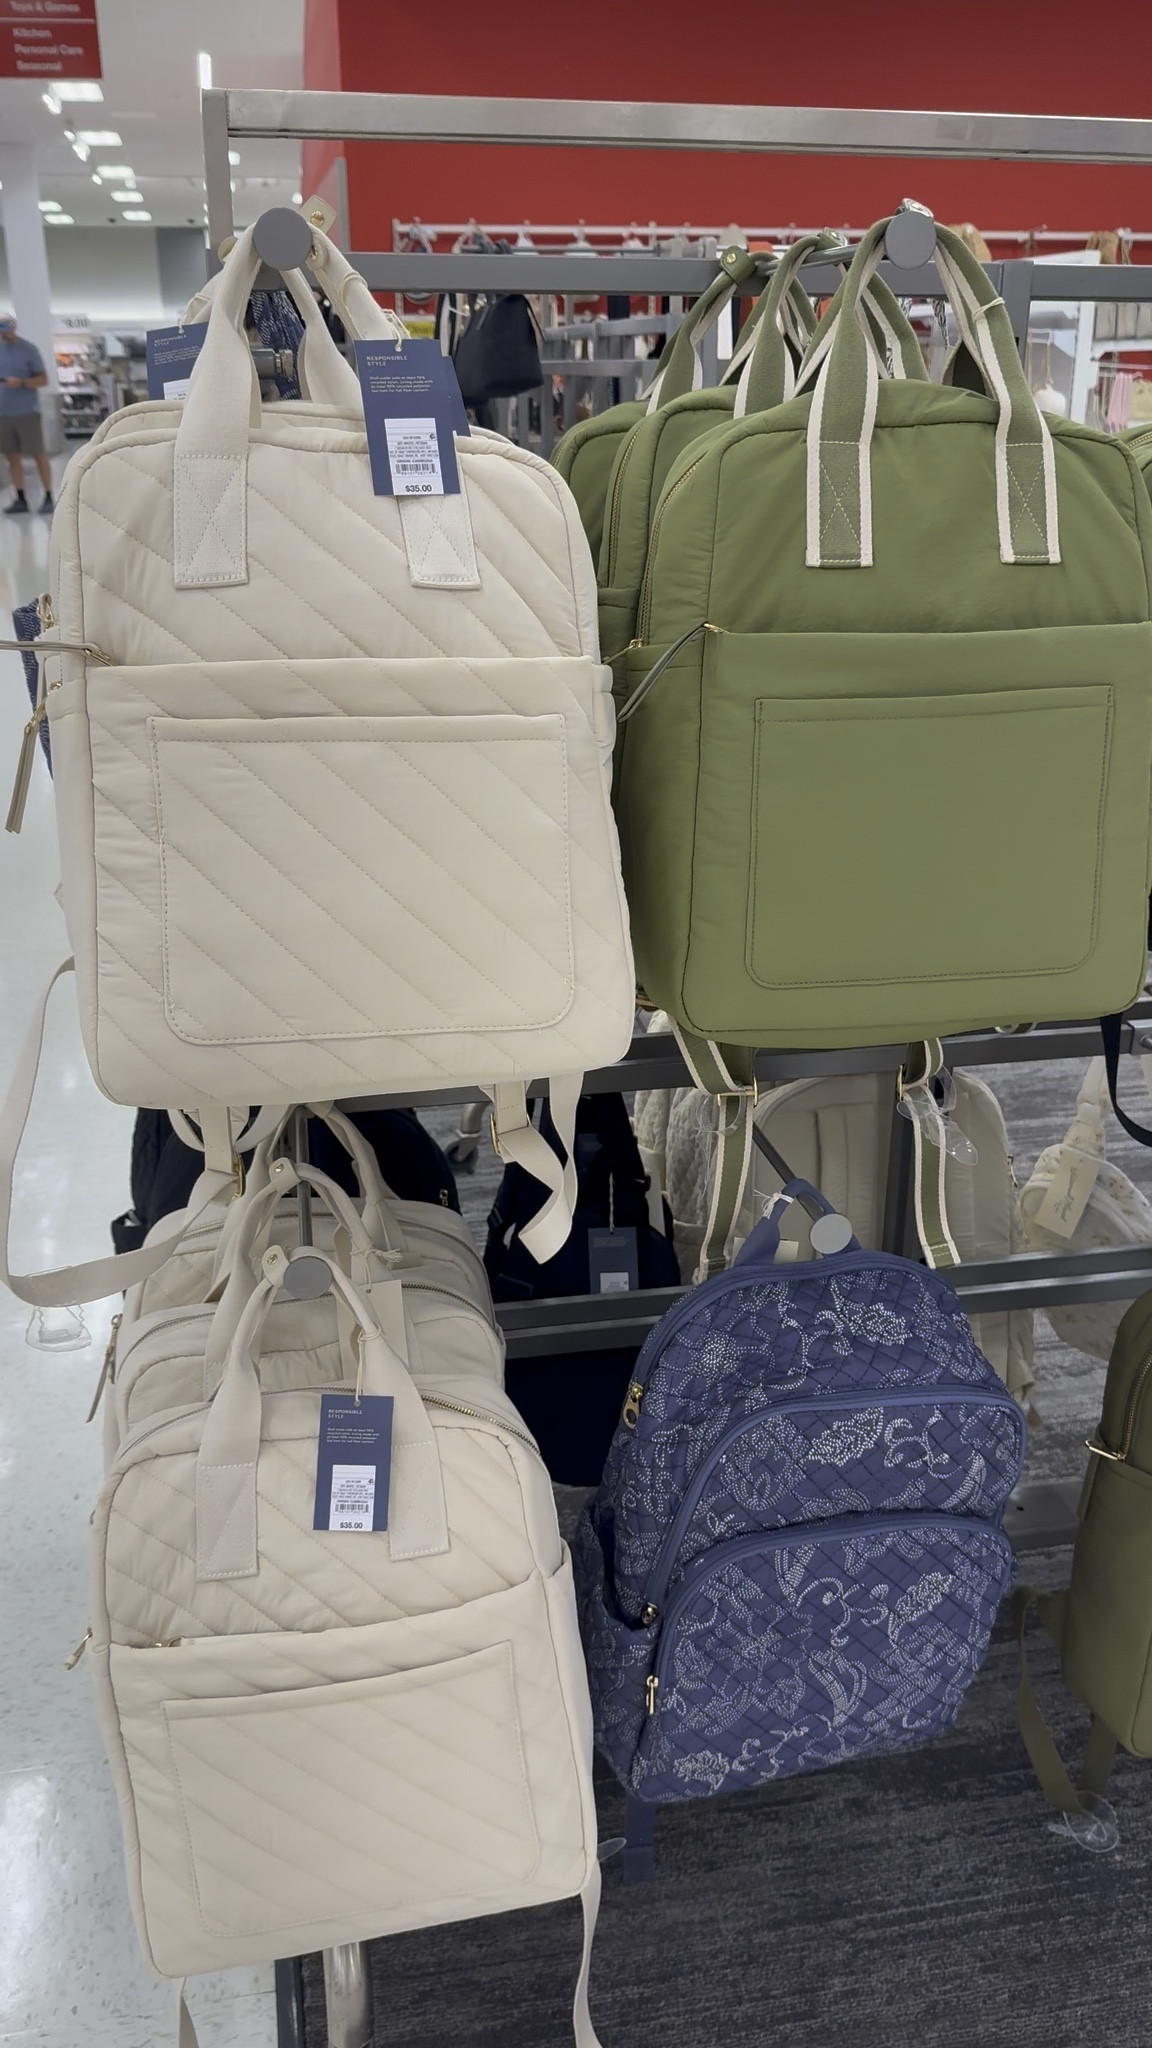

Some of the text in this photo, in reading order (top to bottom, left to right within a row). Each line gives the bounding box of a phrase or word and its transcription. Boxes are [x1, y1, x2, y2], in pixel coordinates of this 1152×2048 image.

[12, 27, 53, 38] Kitchen
[14, 43, 84, 56] Personal Care
[16, 60, 63, 71] Seasonal
[405, 484, 432, 493] $35.00
